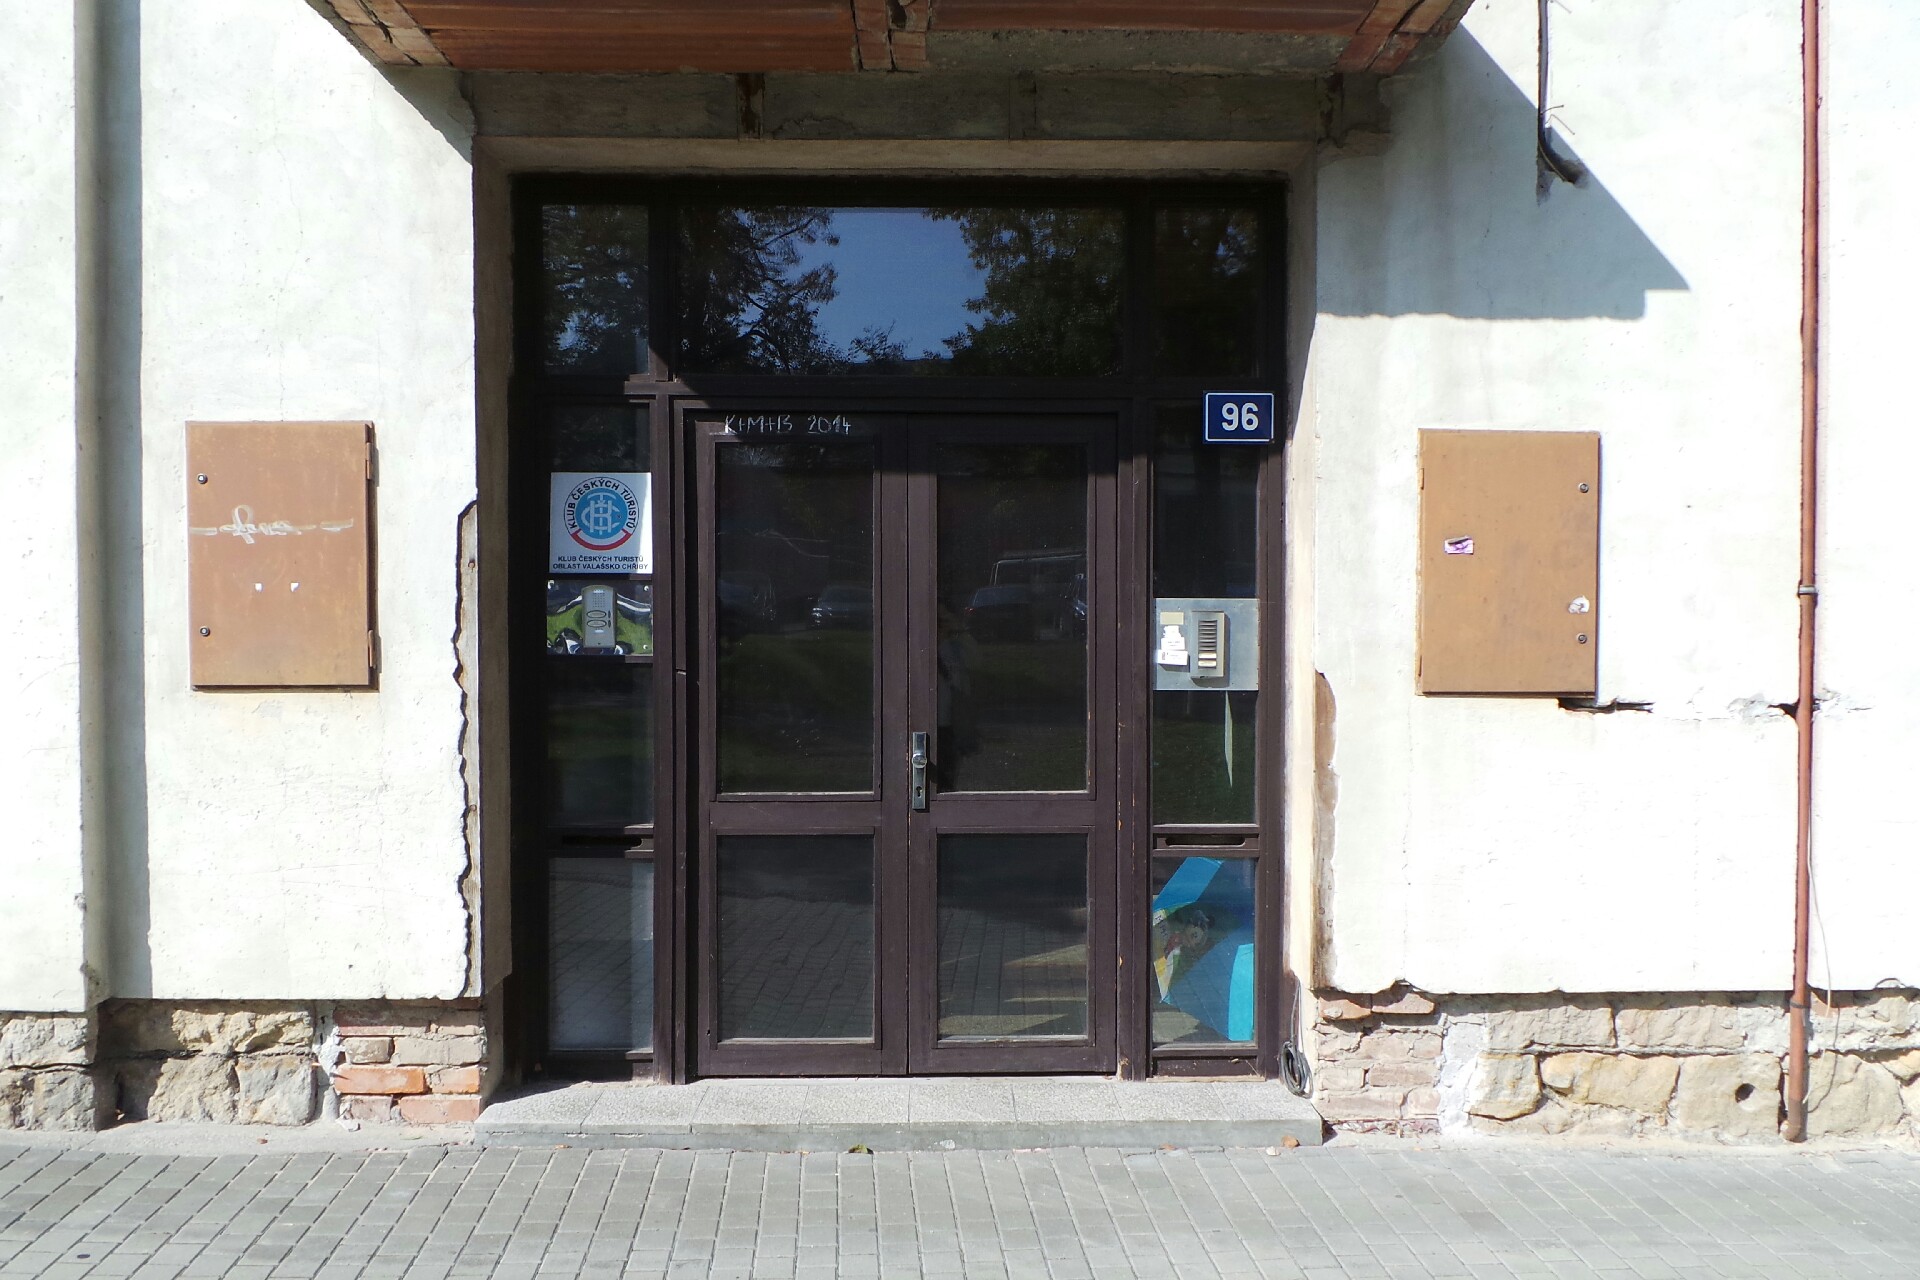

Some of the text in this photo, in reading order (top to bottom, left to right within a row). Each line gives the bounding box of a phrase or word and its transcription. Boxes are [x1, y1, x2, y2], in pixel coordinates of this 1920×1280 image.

[807, 414, 852, 435] 2014
[1221, 402, 1259, 431] 96
[572, 478, 620, 501] ČESKÝCH
[567, 502, 578, 529] KLUB
[620, 489, 637, 529] TURISTŮ
[578, 554, 611, 562] ČESKÝCH
[582, 562, 620, 570] VALAŠSKO
[621, 562, 648, 570] CHŘIBY
